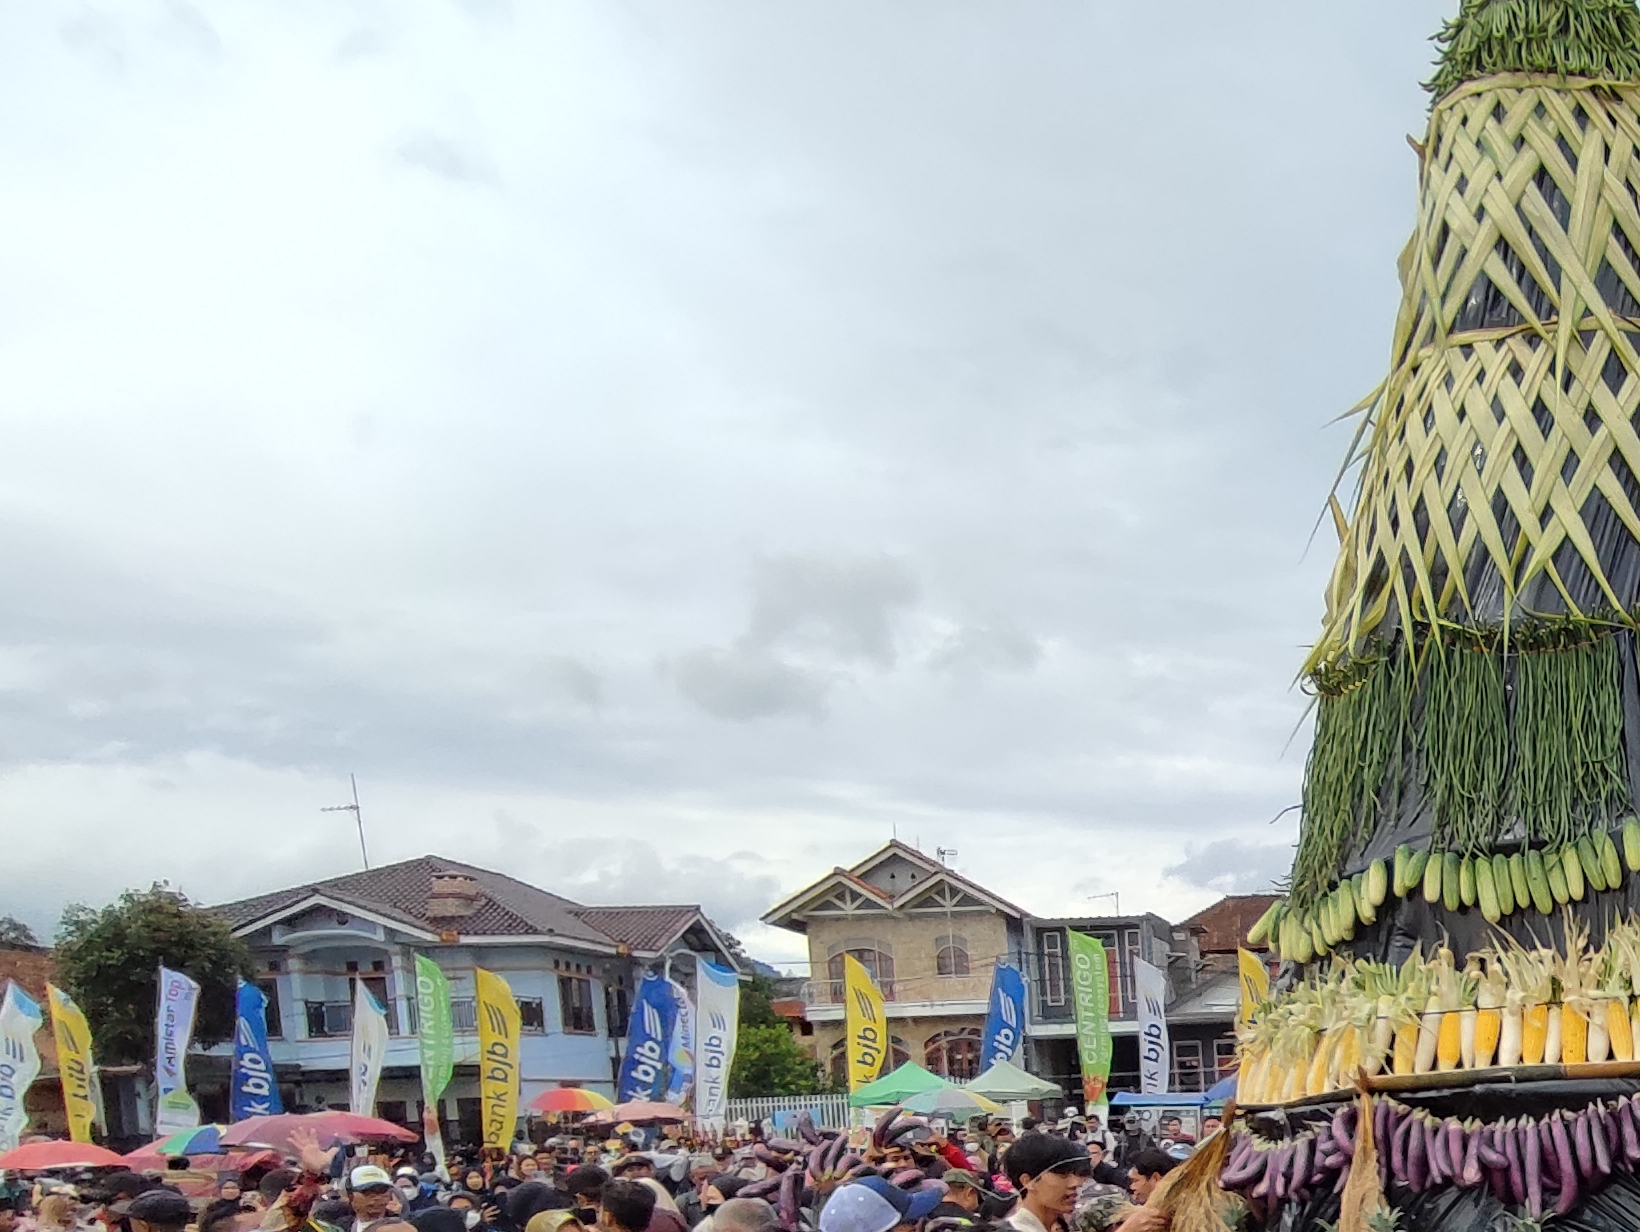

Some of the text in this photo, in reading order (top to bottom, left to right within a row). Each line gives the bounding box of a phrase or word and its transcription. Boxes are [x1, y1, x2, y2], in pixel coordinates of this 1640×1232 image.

[418, 975, 435, 1082] NTRIGO
[1075, 953, 1098, 1065] CENTRIGO
[631, 1040, 663, 1083] bjb
[704, 1035, 725, 1069] bjb
[856, 1025, 882, 1068] bjb
[1143, 1022, 1165, 1064] bjb
[239, 1052, 272, 1096] bjb
[486, 1040, 513, 1145] bank bjb
